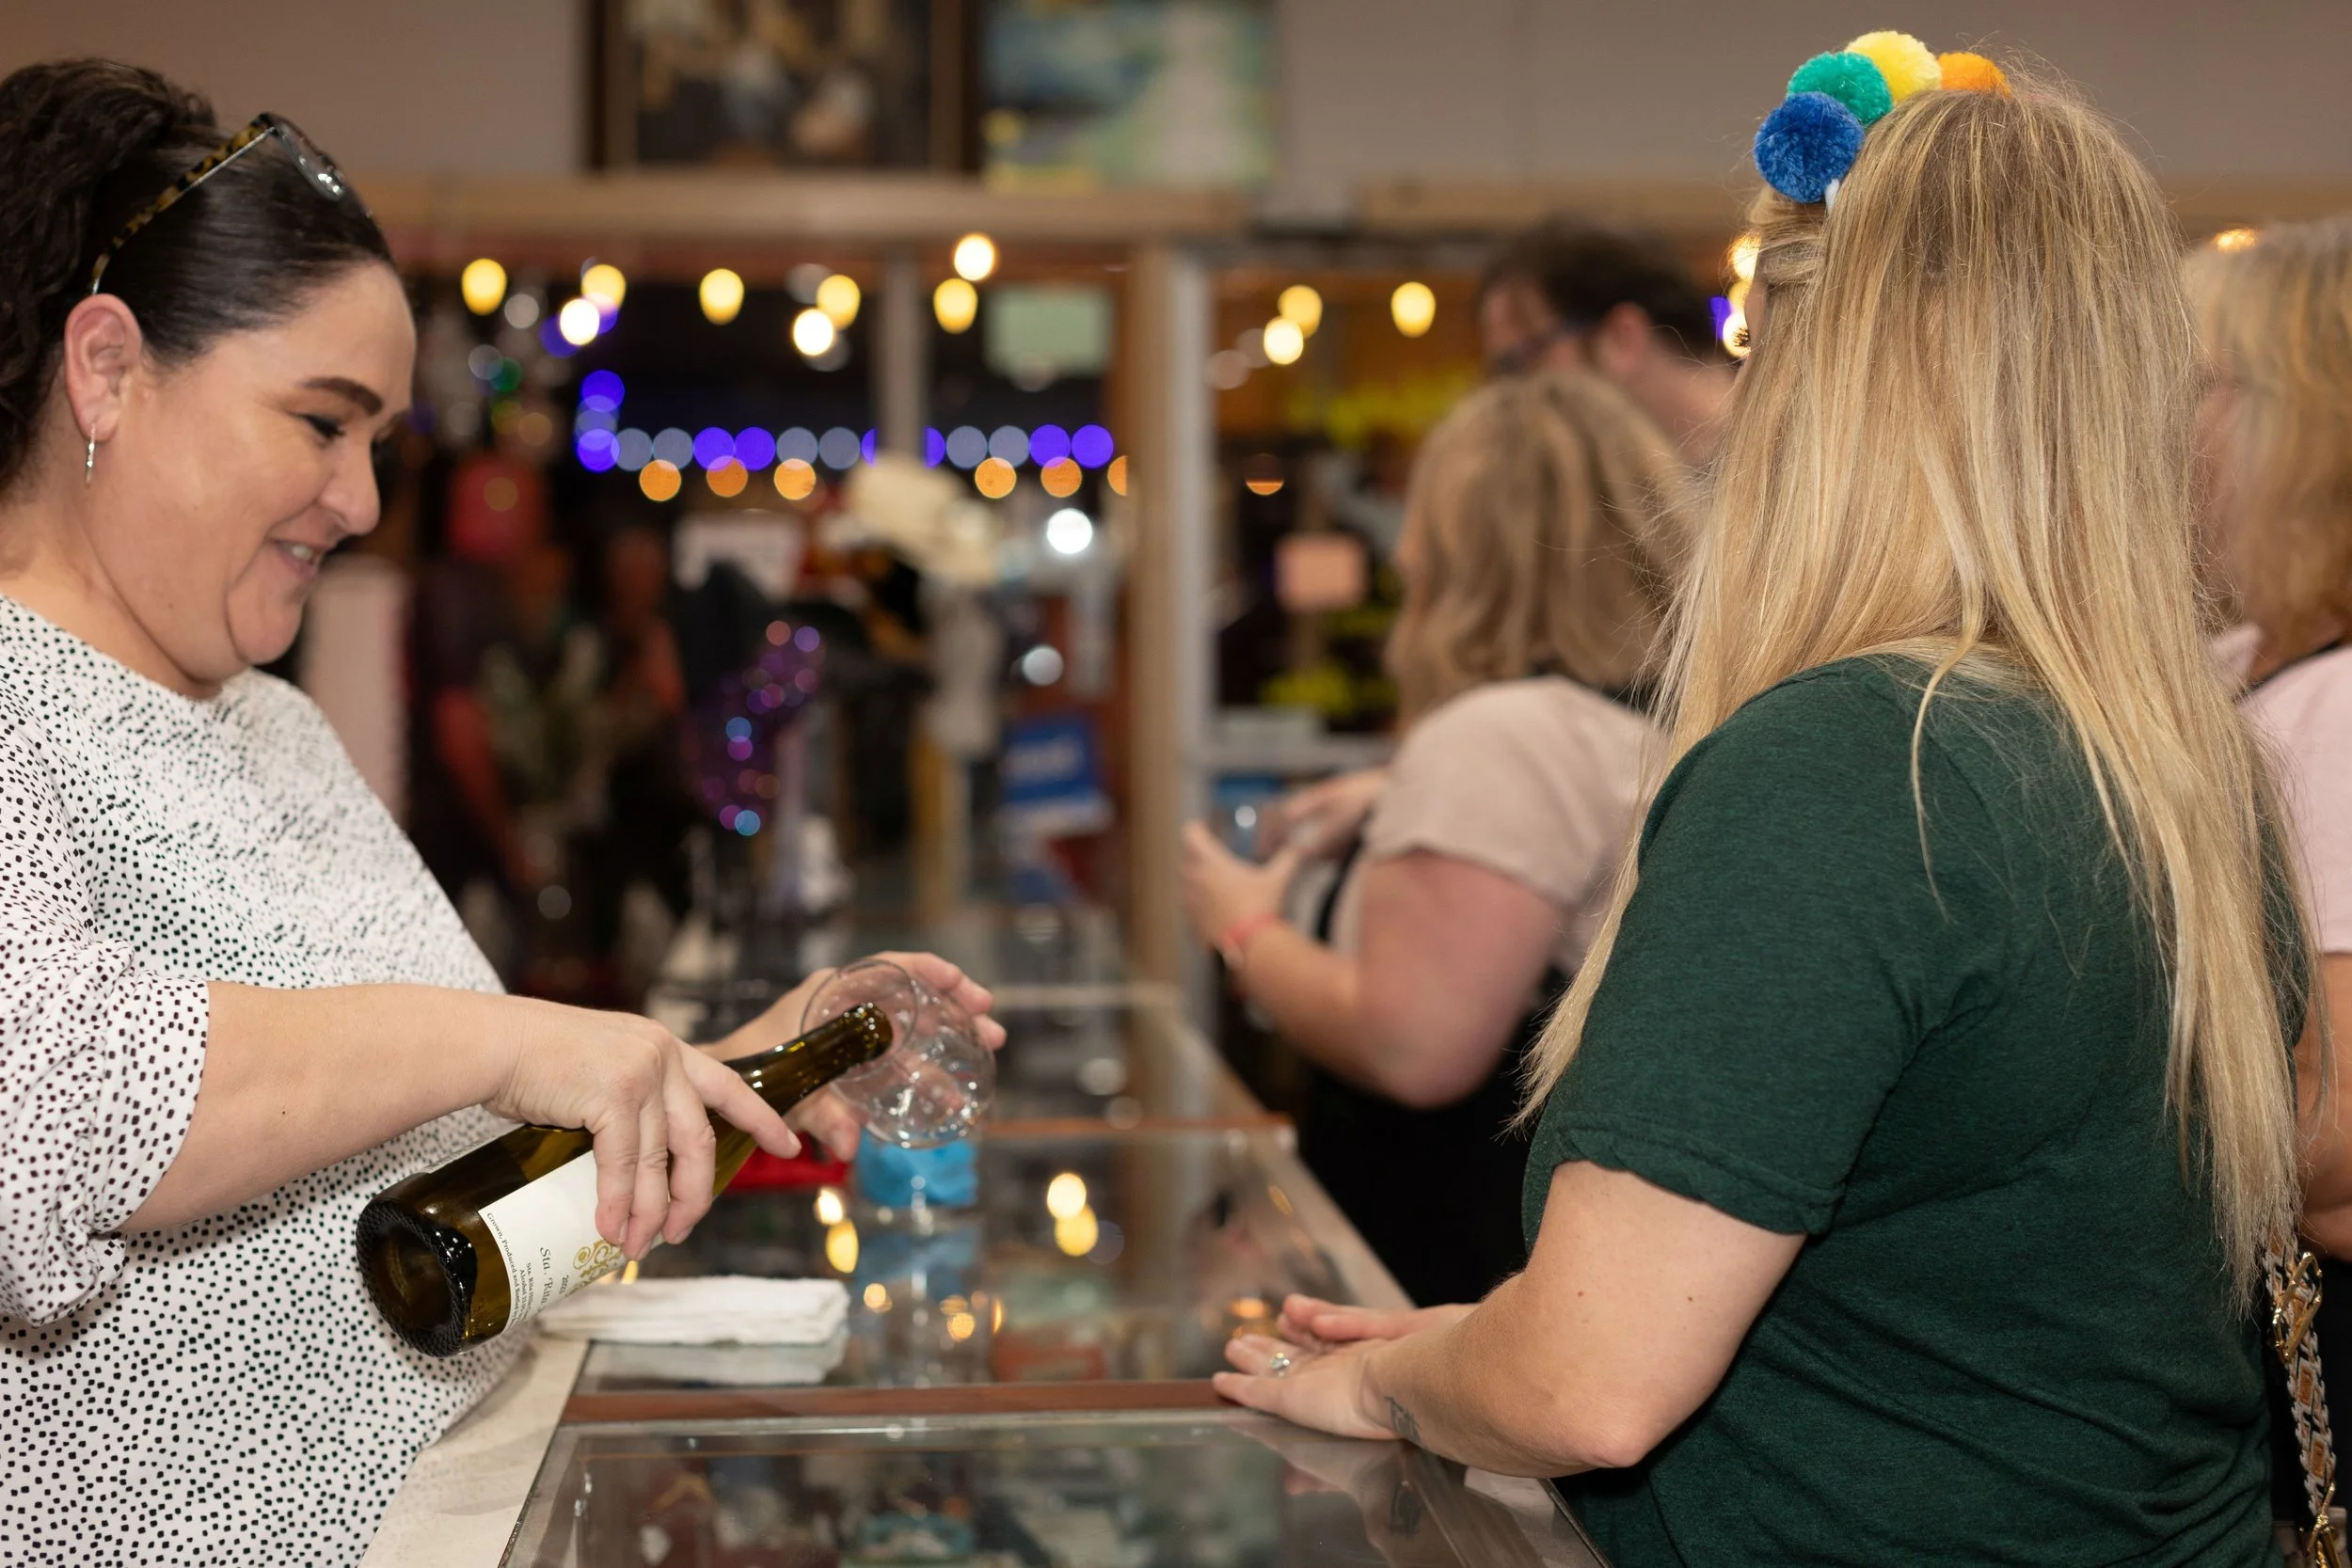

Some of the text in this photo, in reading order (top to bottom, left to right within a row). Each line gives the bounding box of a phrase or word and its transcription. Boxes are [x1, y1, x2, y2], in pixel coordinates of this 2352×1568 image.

[486, 1212, 503, 1240] Grown,
[501, 1239, 517, 1275] Produced
[539, 1247, 551, 1275] Sta.
[519, 1270, 528, 1295] Alcohol
[540, 1277, 554, 1304] Rita
